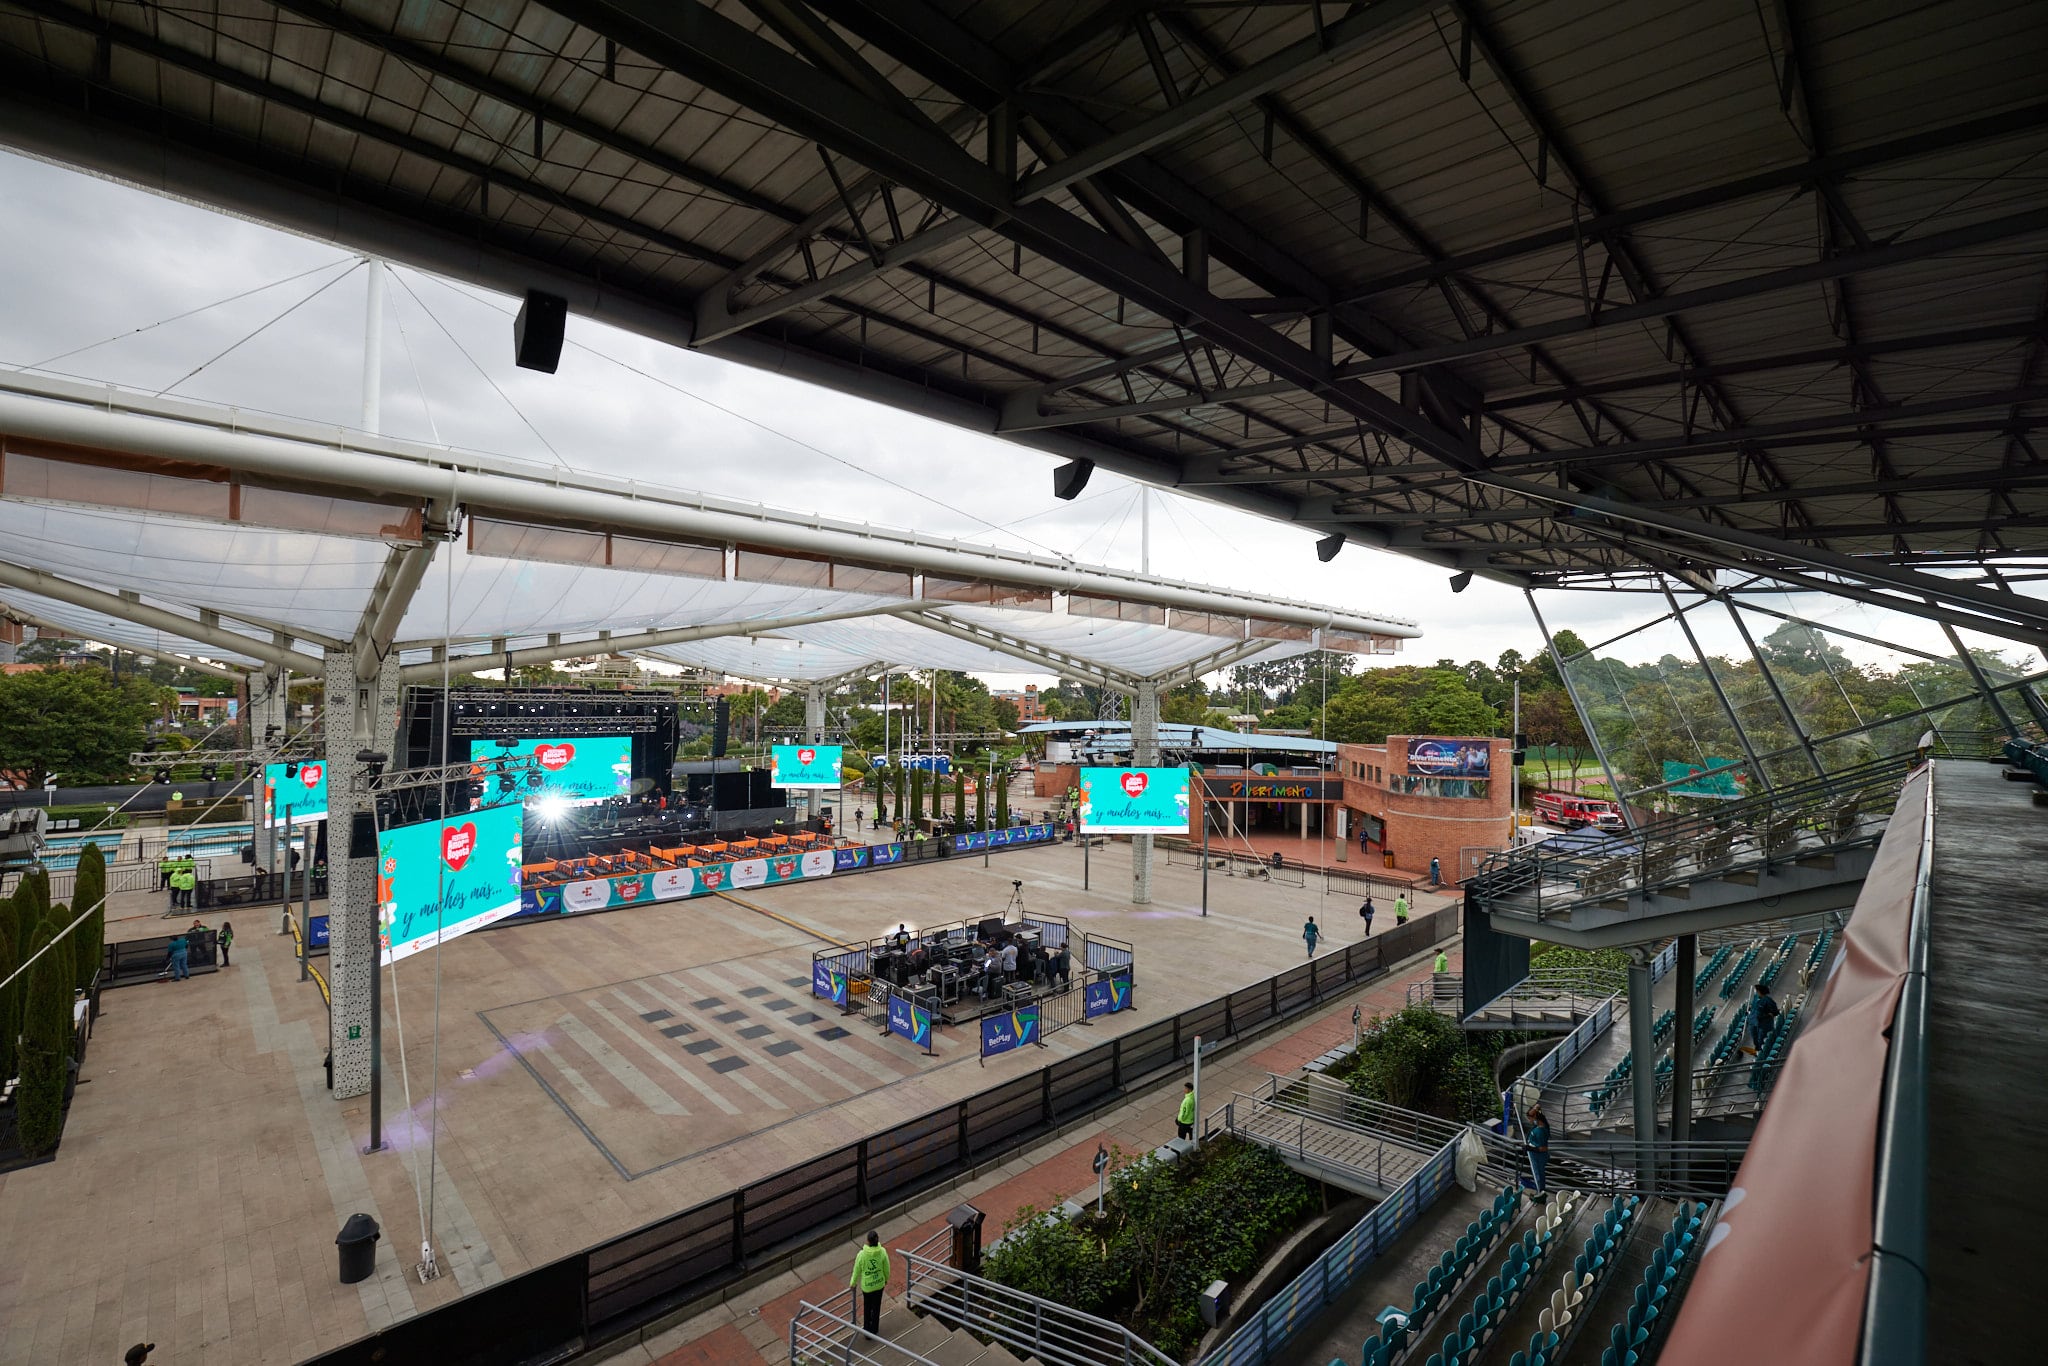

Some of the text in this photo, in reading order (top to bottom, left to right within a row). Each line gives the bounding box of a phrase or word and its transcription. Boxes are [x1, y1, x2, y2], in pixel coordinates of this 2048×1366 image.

[1107, 801, 1140, 819] muchos
[447, 845, 469, 860] Bogotá
[403, 912, 414, 938] y
[989, 1034, 1011, 1047] BetPlay
